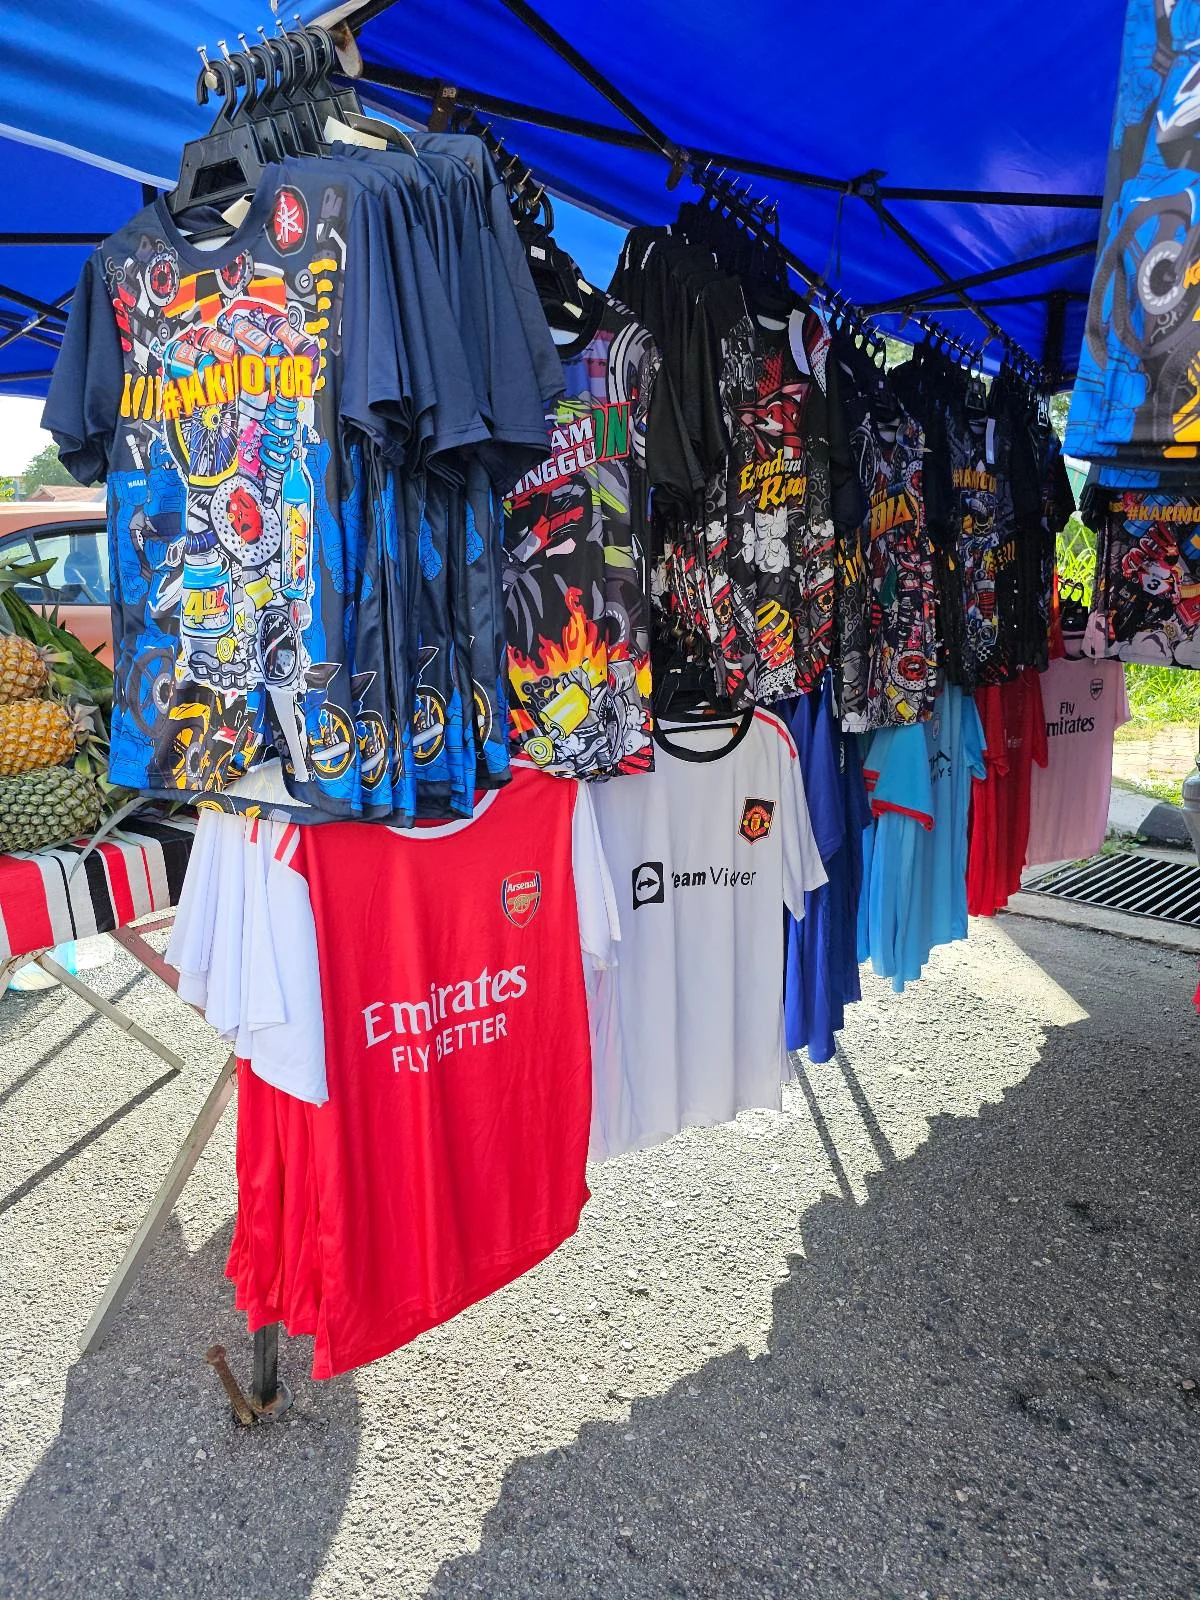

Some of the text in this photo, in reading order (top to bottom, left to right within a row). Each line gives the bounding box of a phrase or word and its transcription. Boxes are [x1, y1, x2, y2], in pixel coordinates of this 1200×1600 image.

[551, 417, 594, 451] AM
[504, 442, 597, 499] INGGU
[1046, 715, 1095, 737] mirates
[1060, 702, 1075, 716] Fly
[507, 879, 536, 893] Arsenal
[361, 965, 527, 1048] Emirates
[391, 1013, 508, 1073] FLY BETTER
